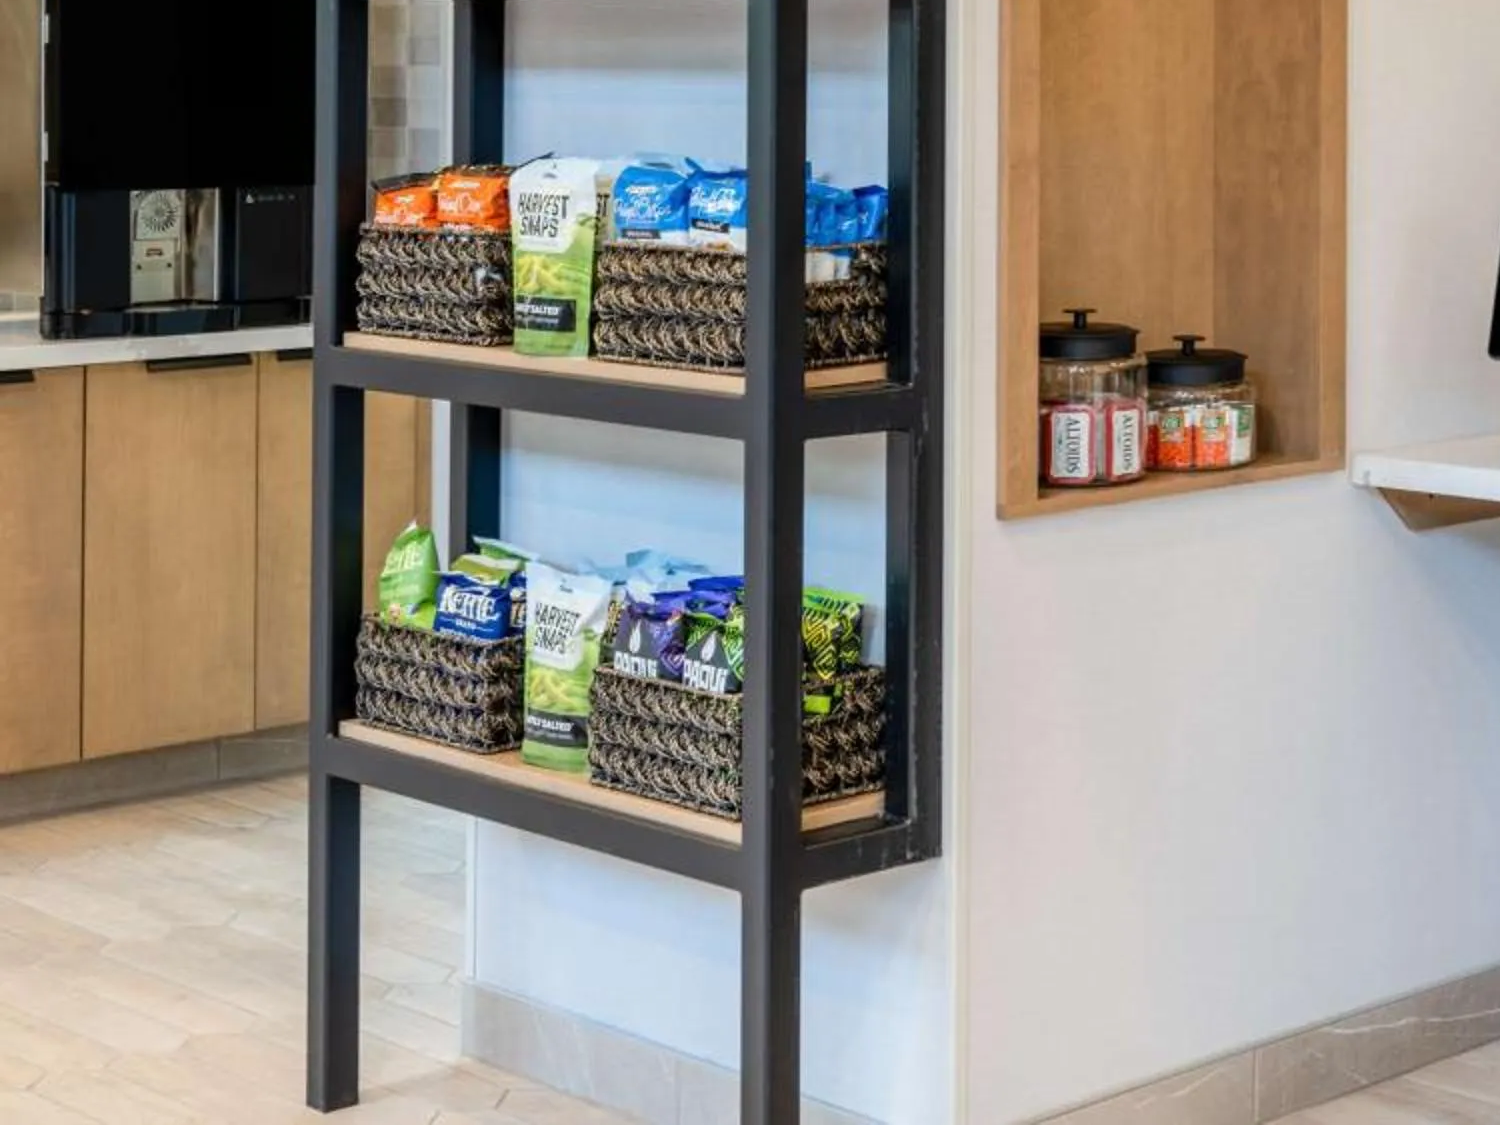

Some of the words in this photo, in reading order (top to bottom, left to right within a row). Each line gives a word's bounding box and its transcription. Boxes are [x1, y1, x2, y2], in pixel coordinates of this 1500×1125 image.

[518, 193, 571, 219] HARVEST
[519, 218, 559, 238] SNAPS
[1065, 416, 1081, 473] ALTOIDS
